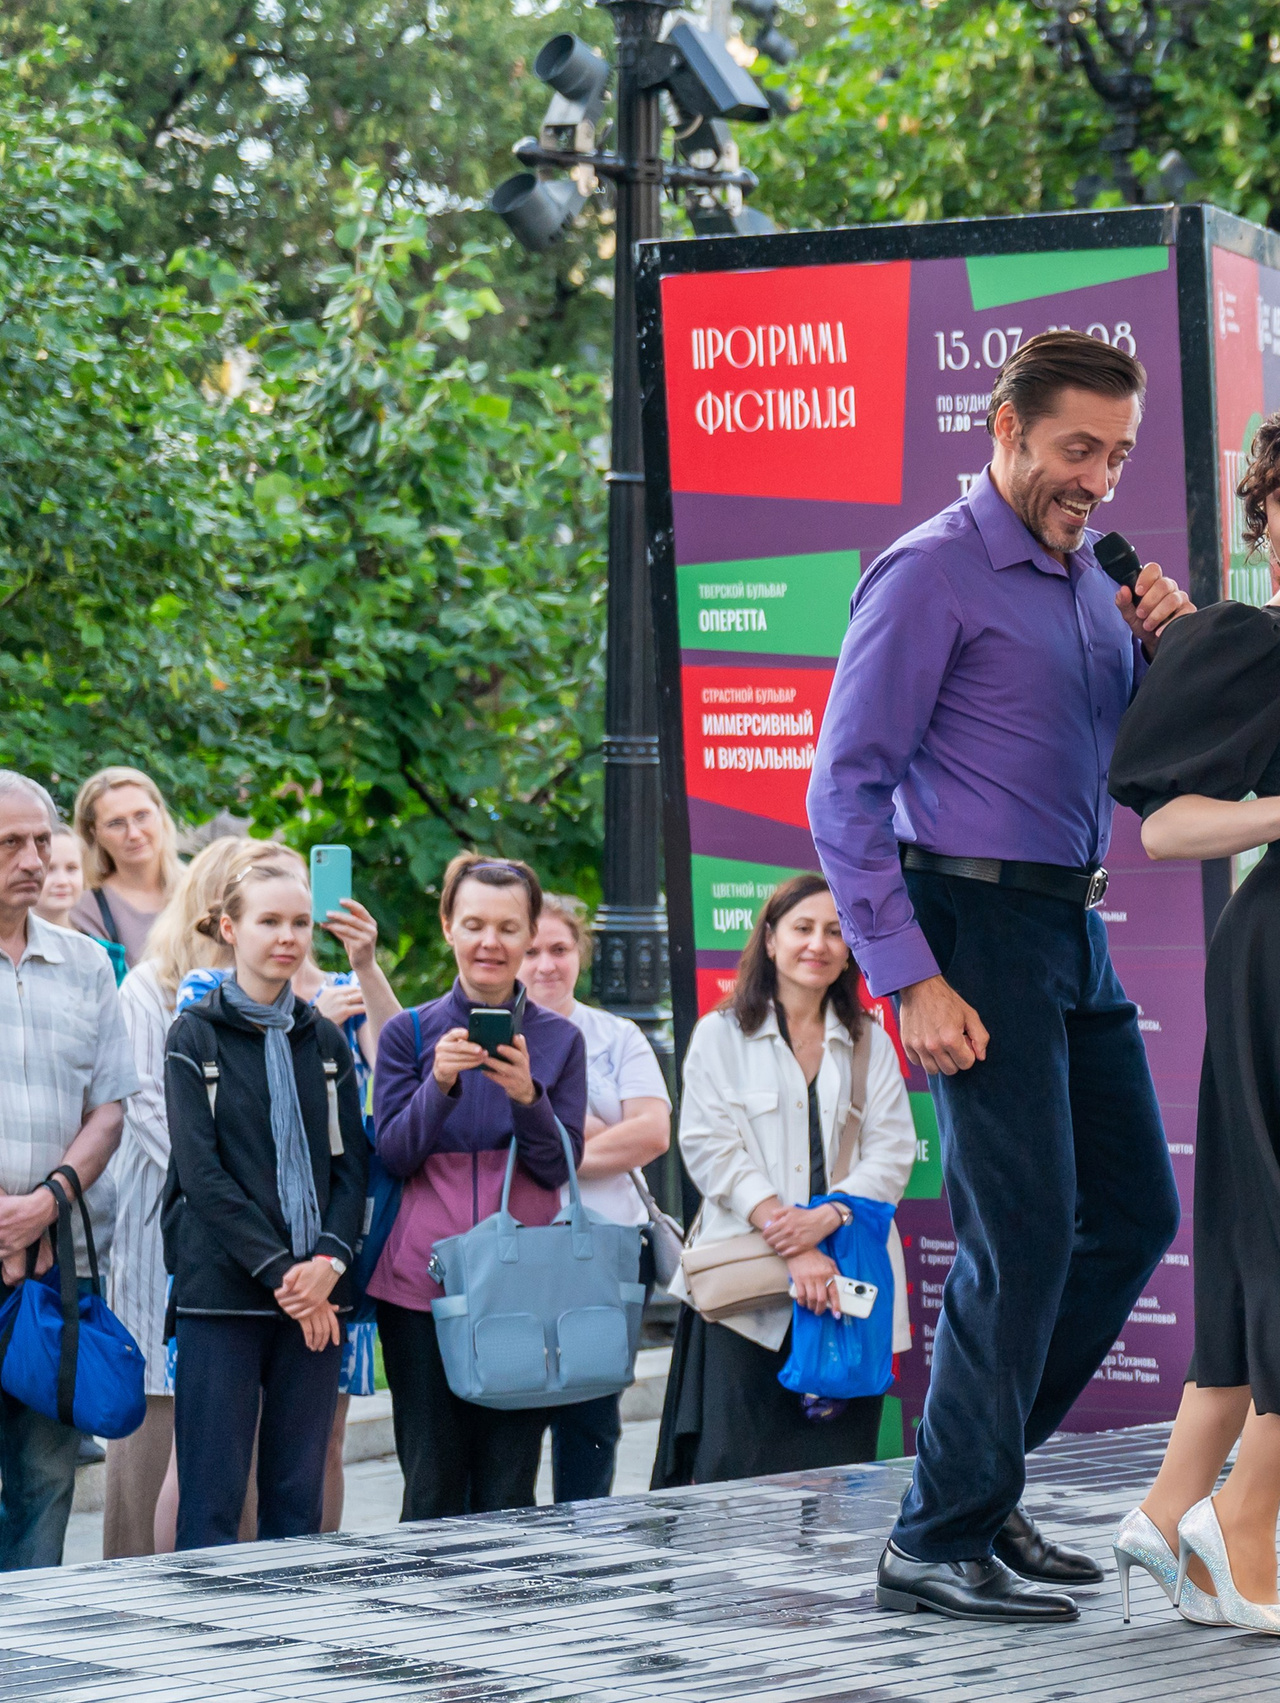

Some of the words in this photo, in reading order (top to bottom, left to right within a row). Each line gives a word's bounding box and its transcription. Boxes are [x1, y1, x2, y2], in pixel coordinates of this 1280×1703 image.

[691, 321, 848, 370] ПРОГРАММА
[935, 327, 1023, 371] 15.07
[695, 385, 856, 435] ФЕСТИВАЛЯ
[936, 394, 953, 413] ПО
[955, 393, 992, 413] БУДНЯ
[937, 414, 971, 432] 17.00
[699, 581, 744, 599] ТВЕРСКОЙ
[746, 583, 788, 600] БУЛЬВАР
[698, 608, 768, 632] ОПЕРЕТТА
[702, 685, 754, 704] СТРАСТНОЙ
[755, 688, 797, 705] БУЛЬВАР
[702, 708, 814, 736] ИММЕРСИВНЫЙ
[704, 748, 715, 769] И
[717, 743, 816, 773] ВИЗУАЛЬНЫЙ
[712, 881, 755, 899] ЦВЕТНОЙ
[712, 908, 755, 934] ЦИРК
[920, 1236, 955, 1252] Оперные
[1118, 1353, 1159, 1369] Суханова,
[1107, 1368, 1133, 1382] Елены
[1135, 1370, 1160, 1384] Ревич
